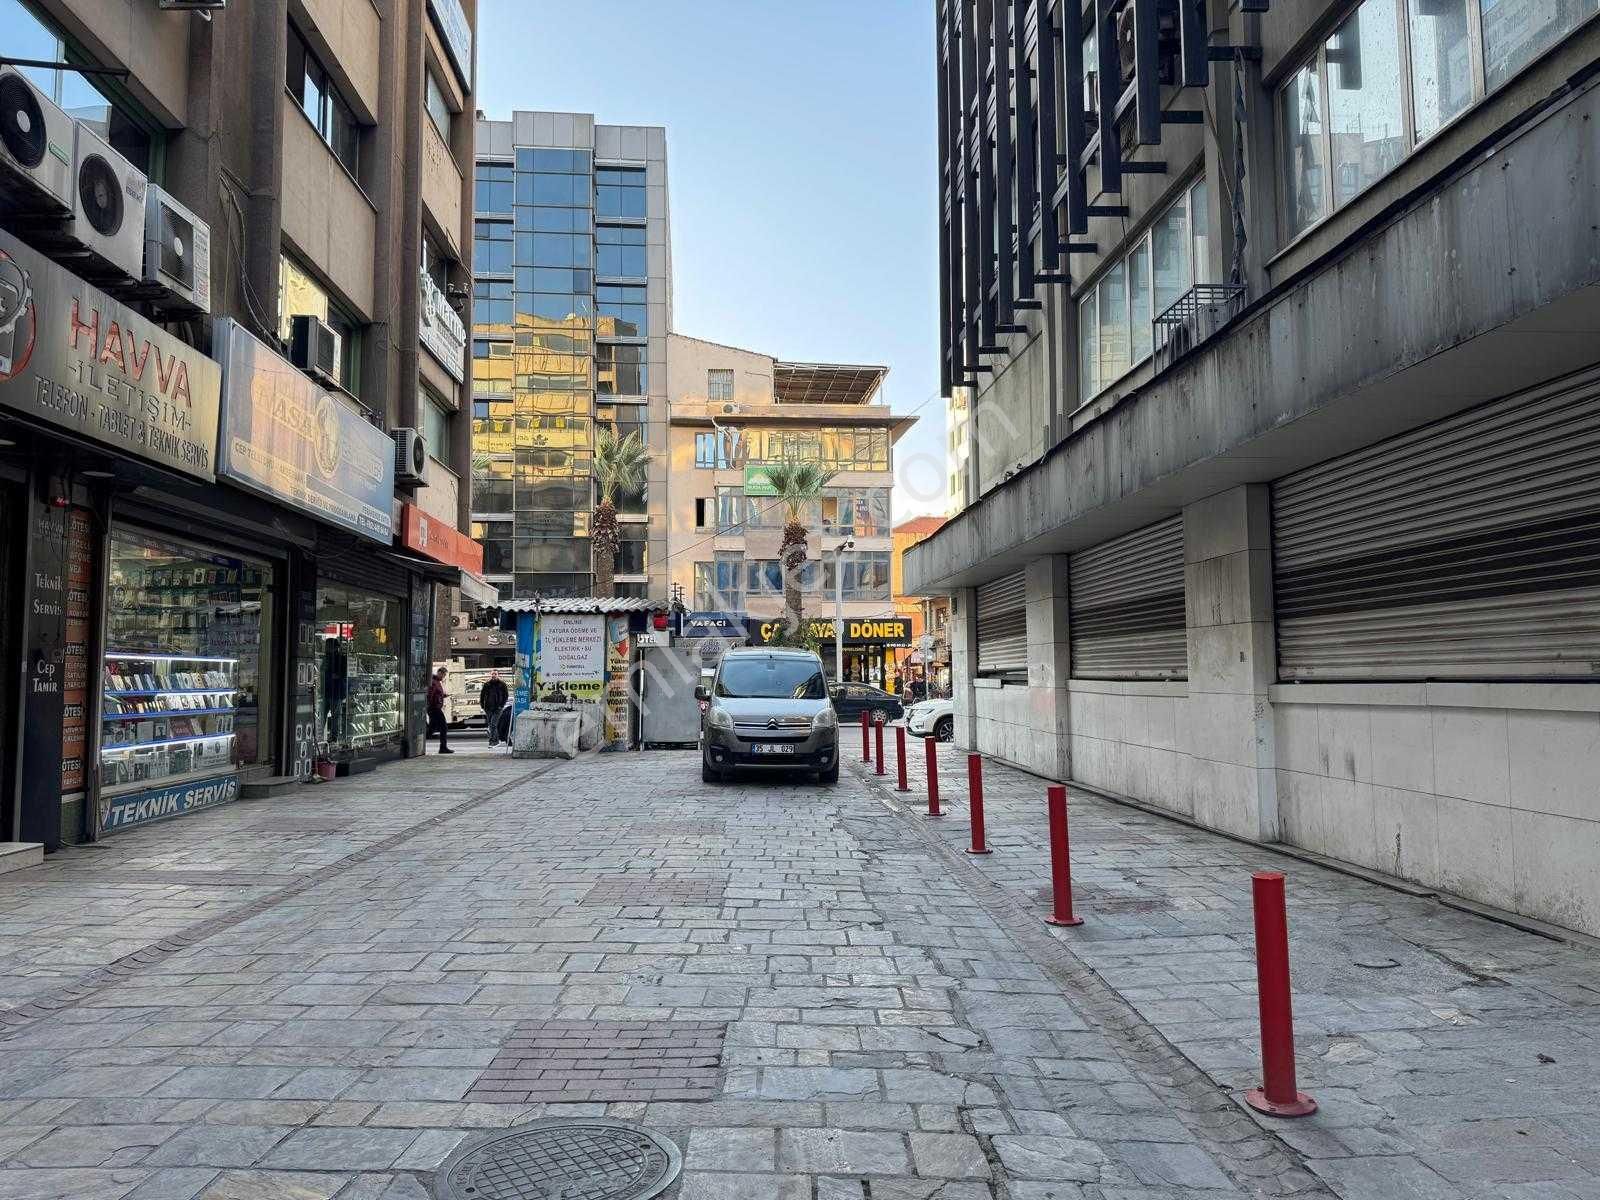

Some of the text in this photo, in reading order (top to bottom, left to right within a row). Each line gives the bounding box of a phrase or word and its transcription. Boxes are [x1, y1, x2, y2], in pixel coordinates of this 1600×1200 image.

[70, 296, 192, 408] HAVVA
[35, 375, 88, 422] TELEFON
[98, 403, 136, 441] TABLET
[148, 425, 180, 459] TEKNİK
[181, 440, 209, 470] SERVİS
[850, 619, 905, 638] DÖNER
[536, 681, 601, 691] Yükleme
[111, 780, 236, 826] TEKNİK SERVİS
